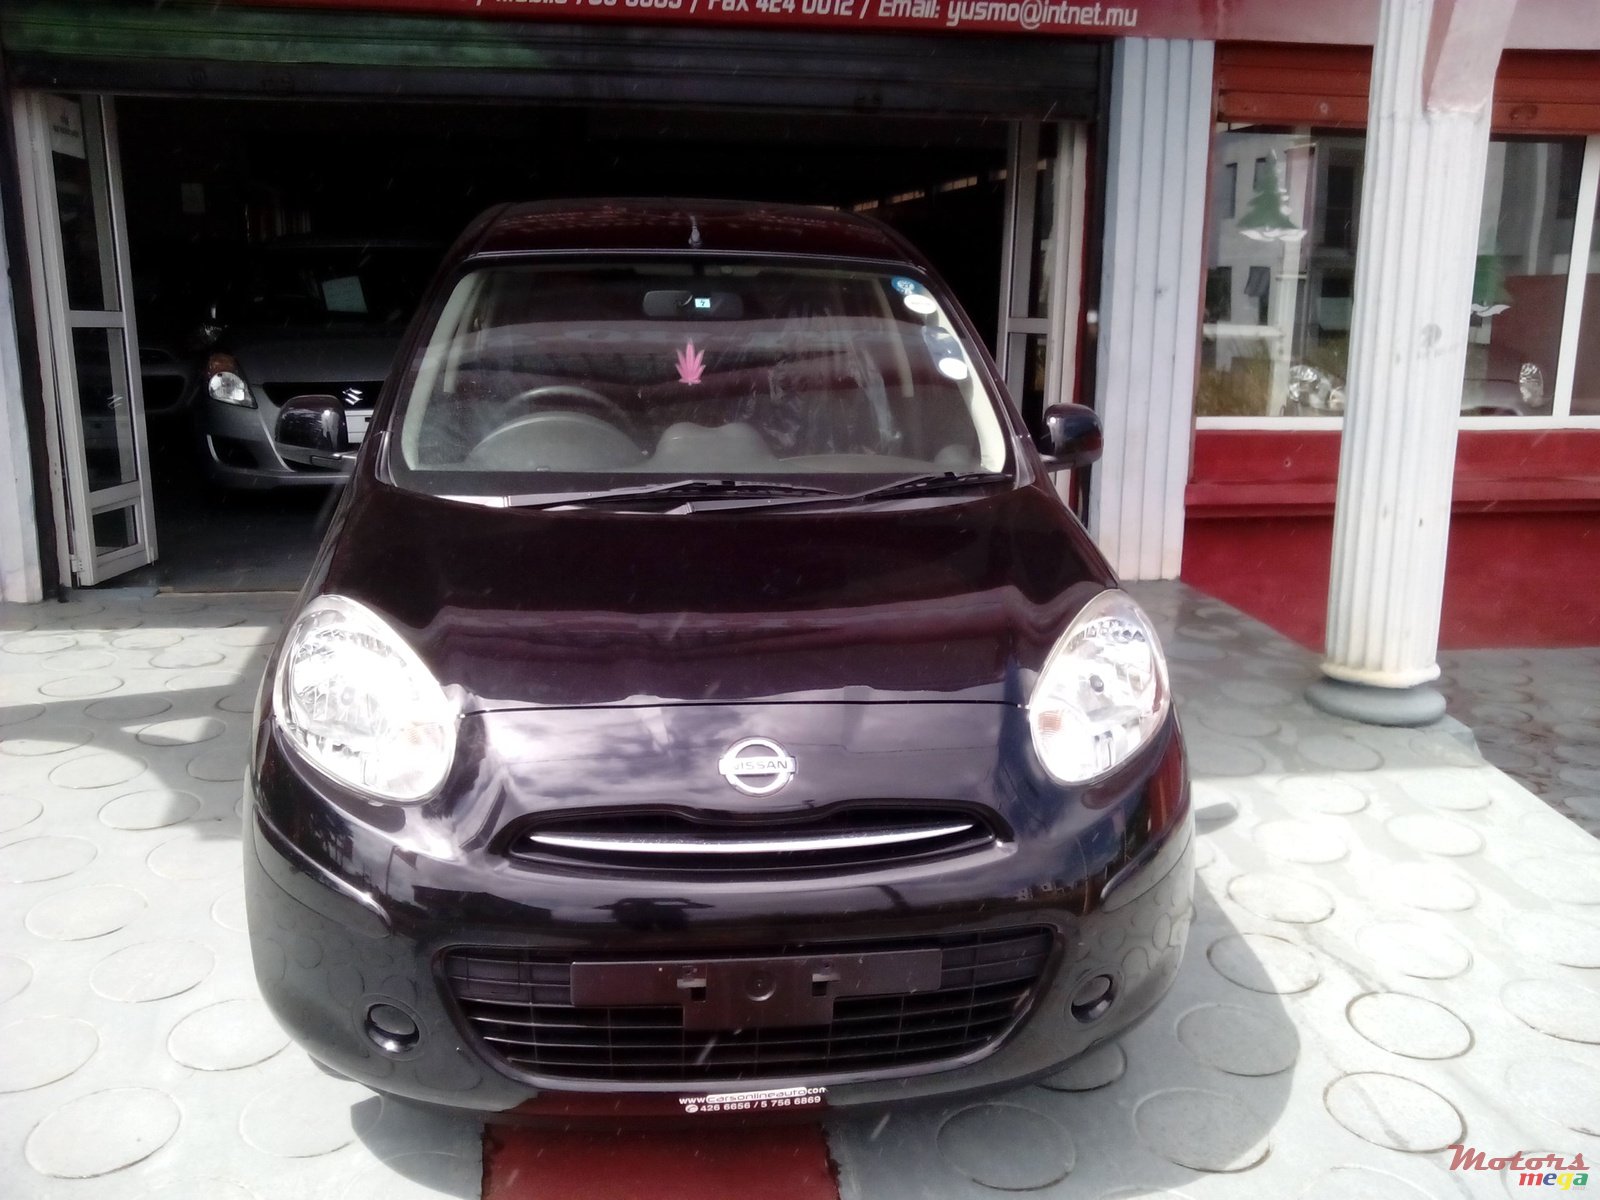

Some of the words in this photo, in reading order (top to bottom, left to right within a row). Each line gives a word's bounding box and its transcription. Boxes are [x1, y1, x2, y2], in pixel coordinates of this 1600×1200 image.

[756, 0, 796, 13] 424
[802, 0, 854, 16] 0012
[878, 0, 941, 18] Email:
[946, 0, 1138, 30] yusmo@intnet.mu
[700, 1104, 720, 1112] 426
[724, 1102, 751, 1111] 6656
[753, 1100, 759, 1109] /
[761, 1100, 768, 1108] 5
[771, 1098, 791, 1107] 756
[794, 1095, 821, 1105] 6869
